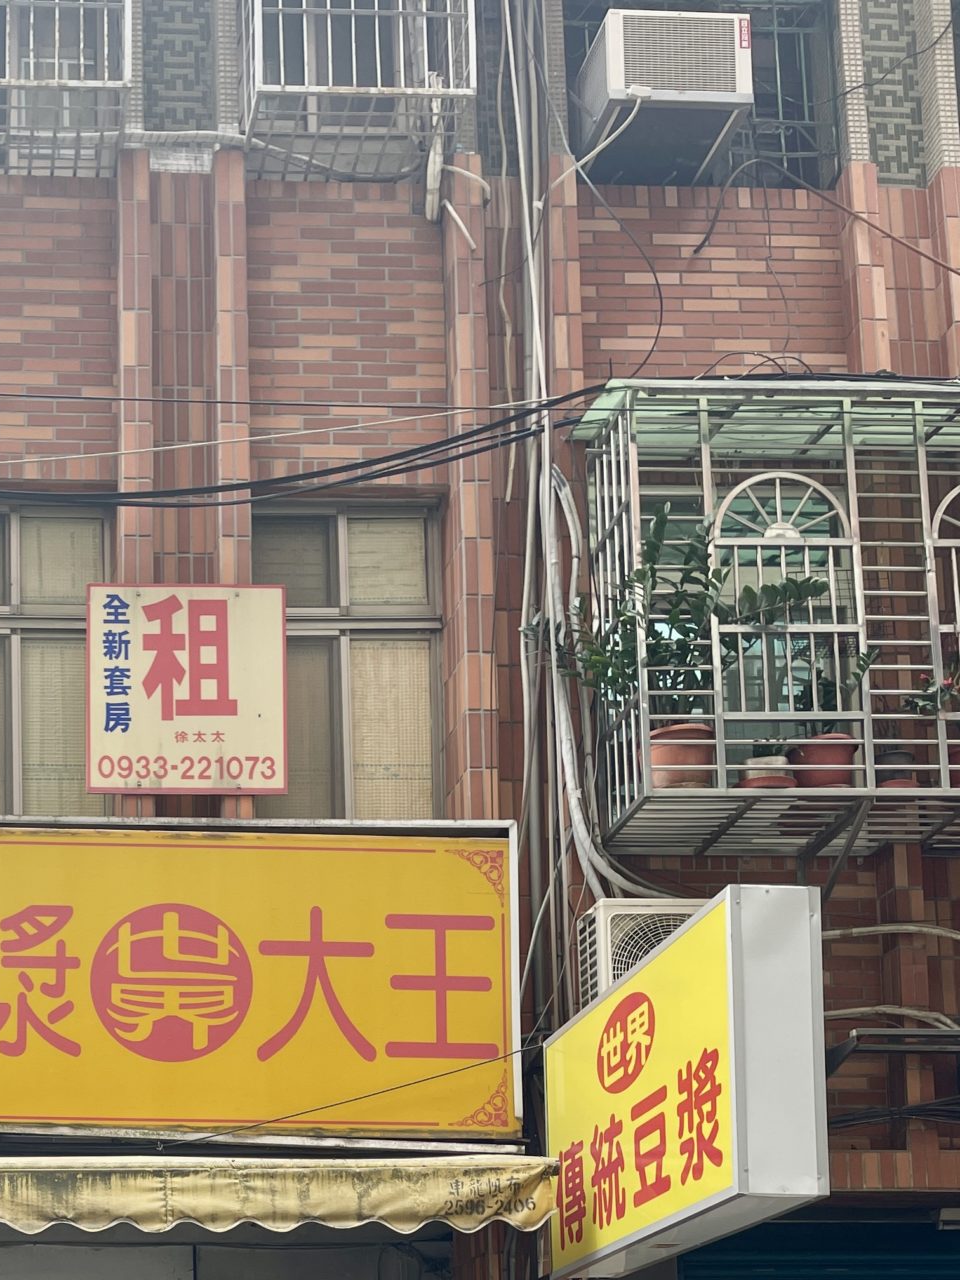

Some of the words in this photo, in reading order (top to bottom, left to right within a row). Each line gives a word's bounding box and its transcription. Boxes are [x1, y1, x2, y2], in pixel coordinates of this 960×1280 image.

[103, 594, 132, 733] 全新套房
[141, 594, 238, 721] 租
[98, 755, 276, 780] 0933-221073
[174, 731, 225, 743] 徐太太
[257, 905, 499, 1062] 大王
[600, 1001, 651, 1085] 世界
[556, 1047, 724, 1250] 傳統豆漿
[444, 1197, 536, 1216] 2596-2406
